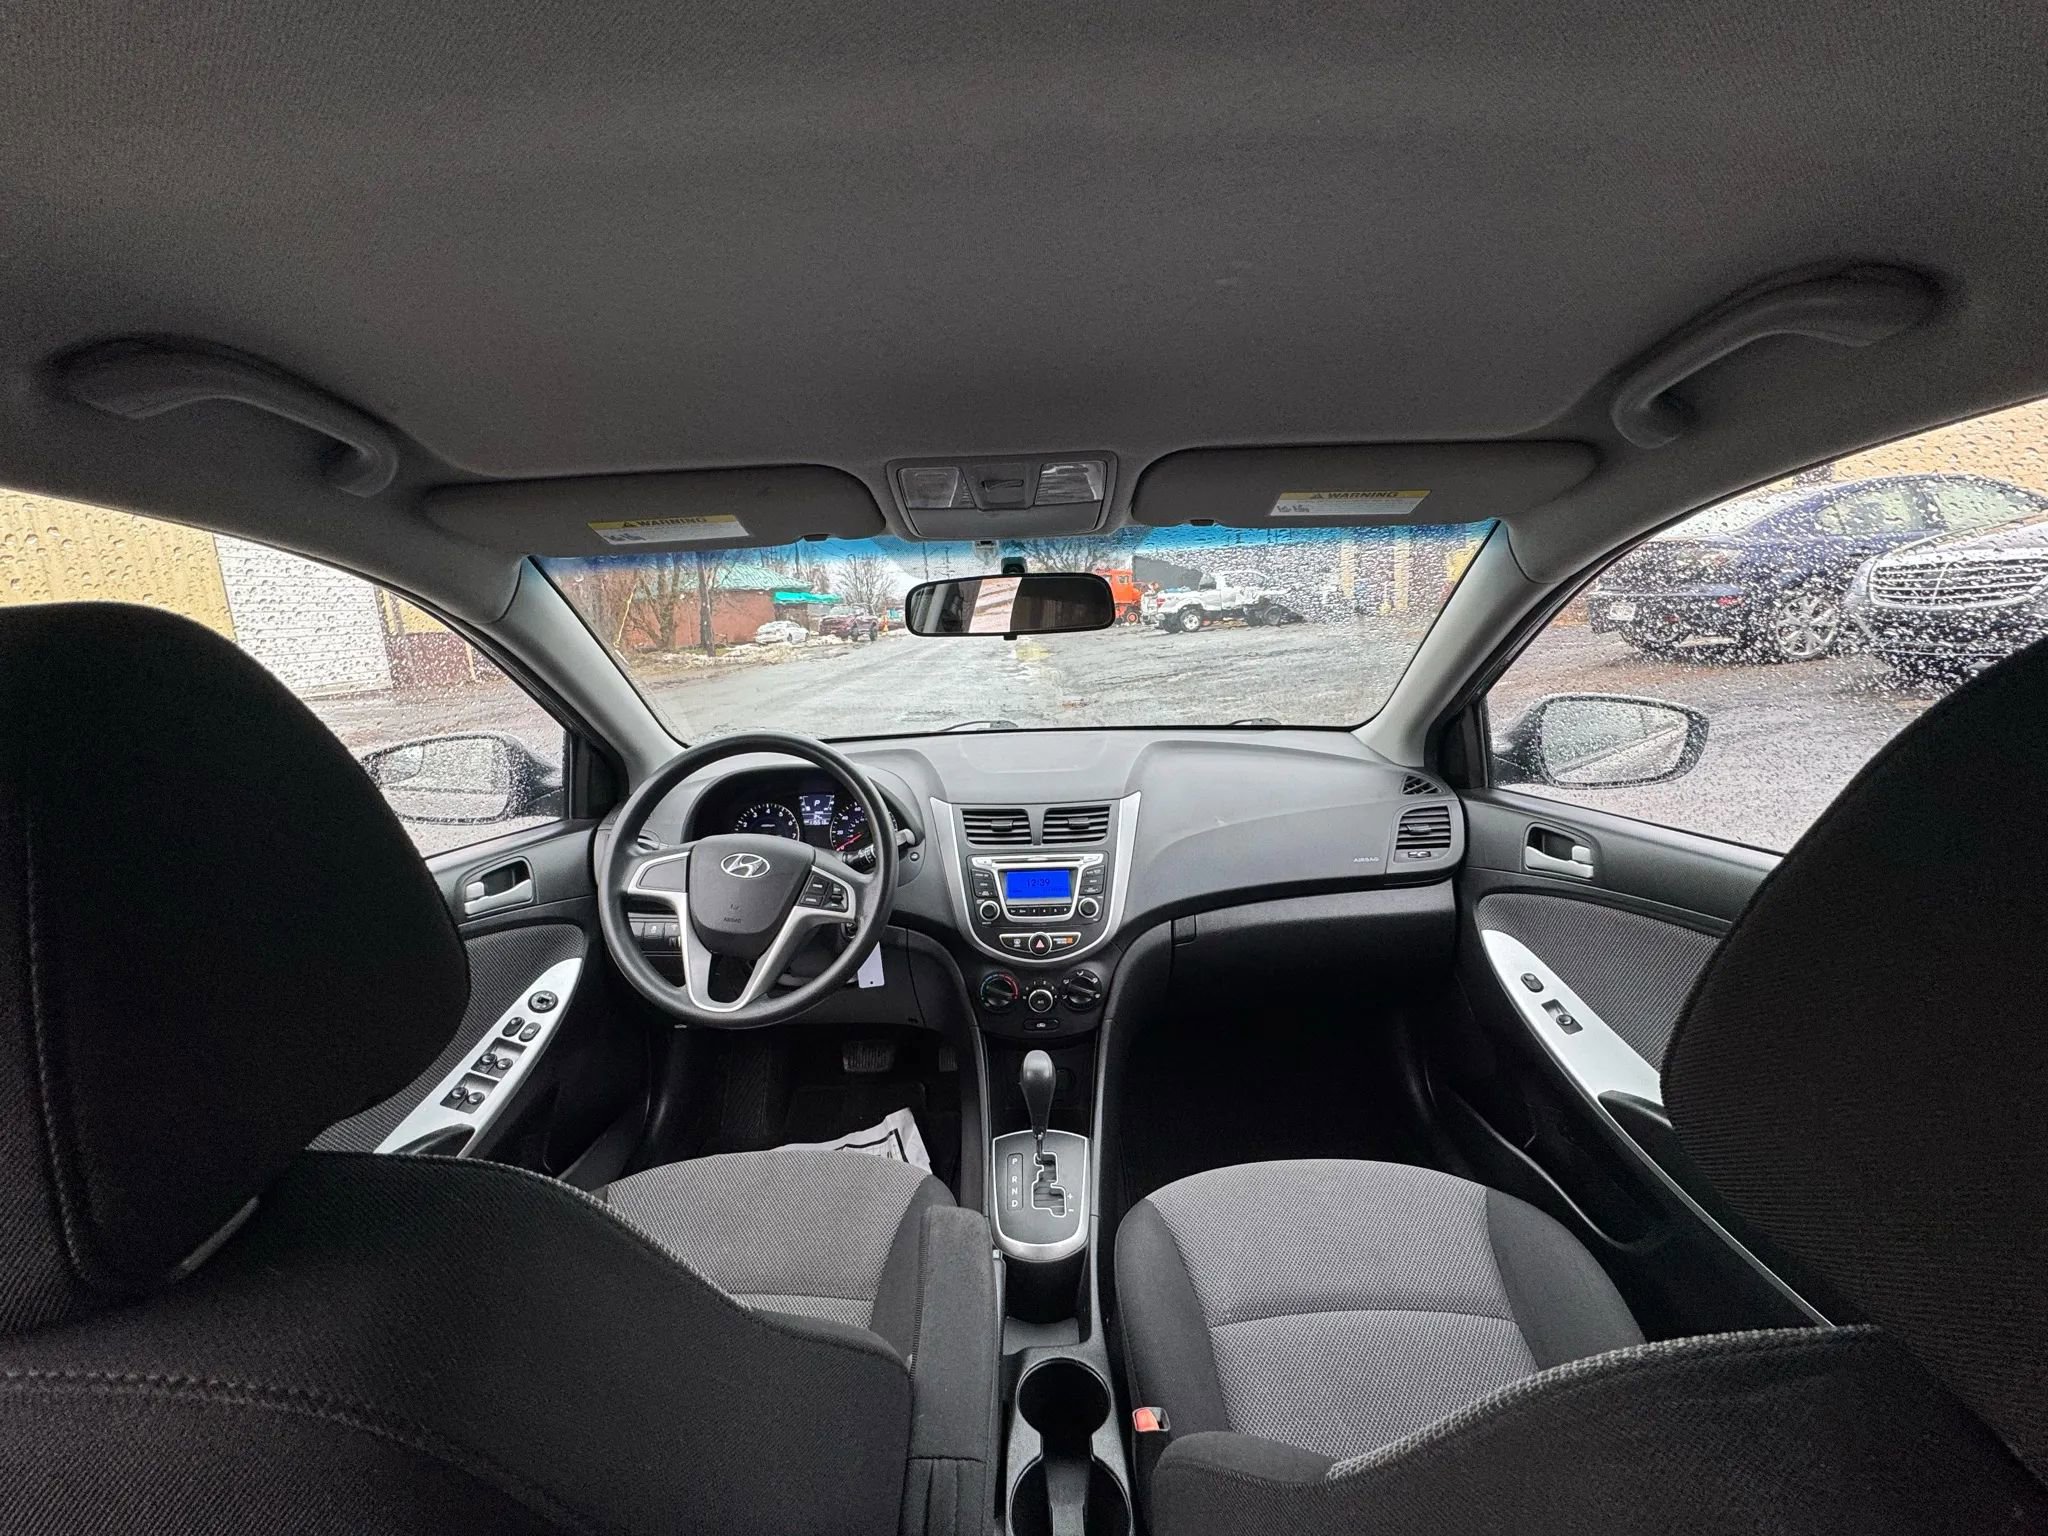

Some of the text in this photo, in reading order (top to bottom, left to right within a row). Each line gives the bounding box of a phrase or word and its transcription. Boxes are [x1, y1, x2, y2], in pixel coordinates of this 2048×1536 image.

[1327, 491, 1399, 499] WARNING
[636, 516, 708, 527] WARNING
[814, 799, 821, 807] P
[1011, 1175, 1018, 1183] R
[1011, 1187, 1018, 1195] N
[1011, 1200, 1018, 1208] D
